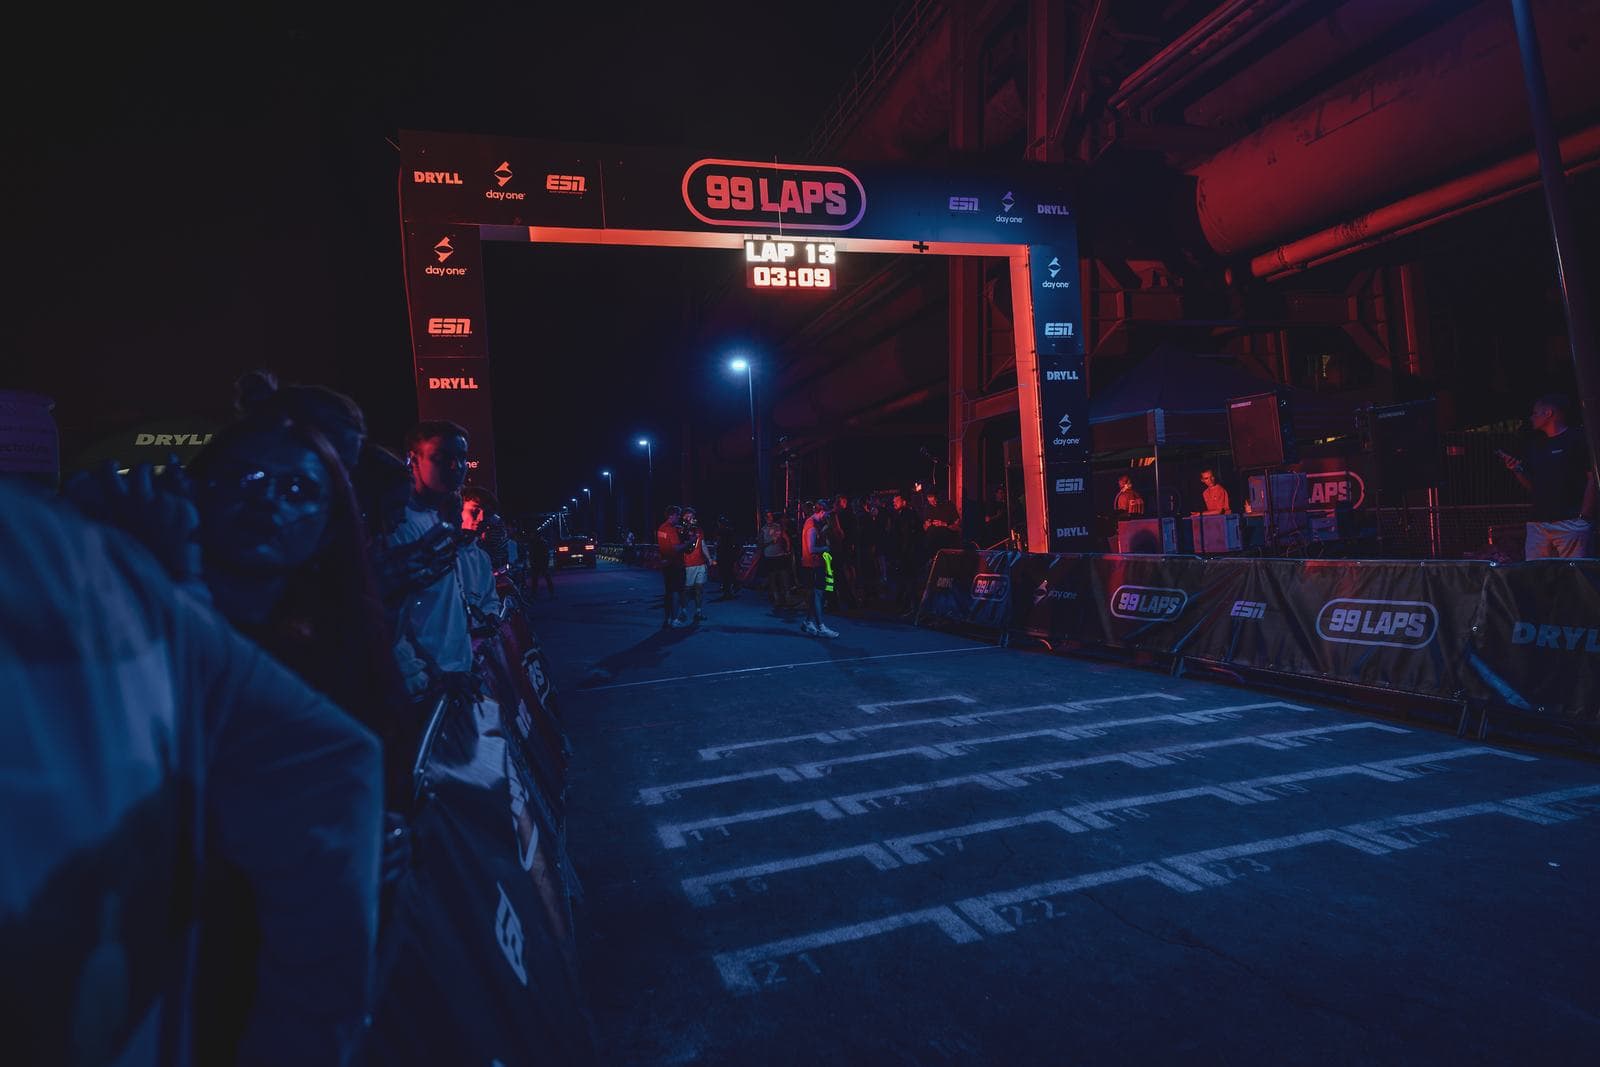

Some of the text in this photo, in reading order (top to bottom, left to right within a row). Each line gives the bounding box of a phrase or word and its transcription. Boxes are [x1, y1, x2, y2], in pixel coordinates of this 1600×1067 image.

[413, 171, 463, 185] DRYLL
[546, 174, 587, 192] ESN
[485, 190, 524, 201] day one
[705, 175, 847, 216] 99 LAPS
[1037, 204, 1070, 216] DRYLL
[995, 214, 1010, 224] day
[746, 241, 836, 265] LAP 13
[425, 266, 466, 277] day one
[753, 266, 831, 287] 03:09
[1042, 279, 1069, 290] day one
[428, 318, 471, 335] ESN
[1046, 370, 1079, 381] DRYLL
[428, 377, 479, 390] DRYLL
[464, 460, 478, 469] ne
[1308, 480, 1347, 505] APS
[1057, 527, 1088, 538] DRYLL
[1118, 592, 1180, 615] 99 LAPS
[1328, 608, 1427, 638] 99 LAPS
[1512, 621, 1600, 652] DRYL
[997, 898, 1069, 927] 22
